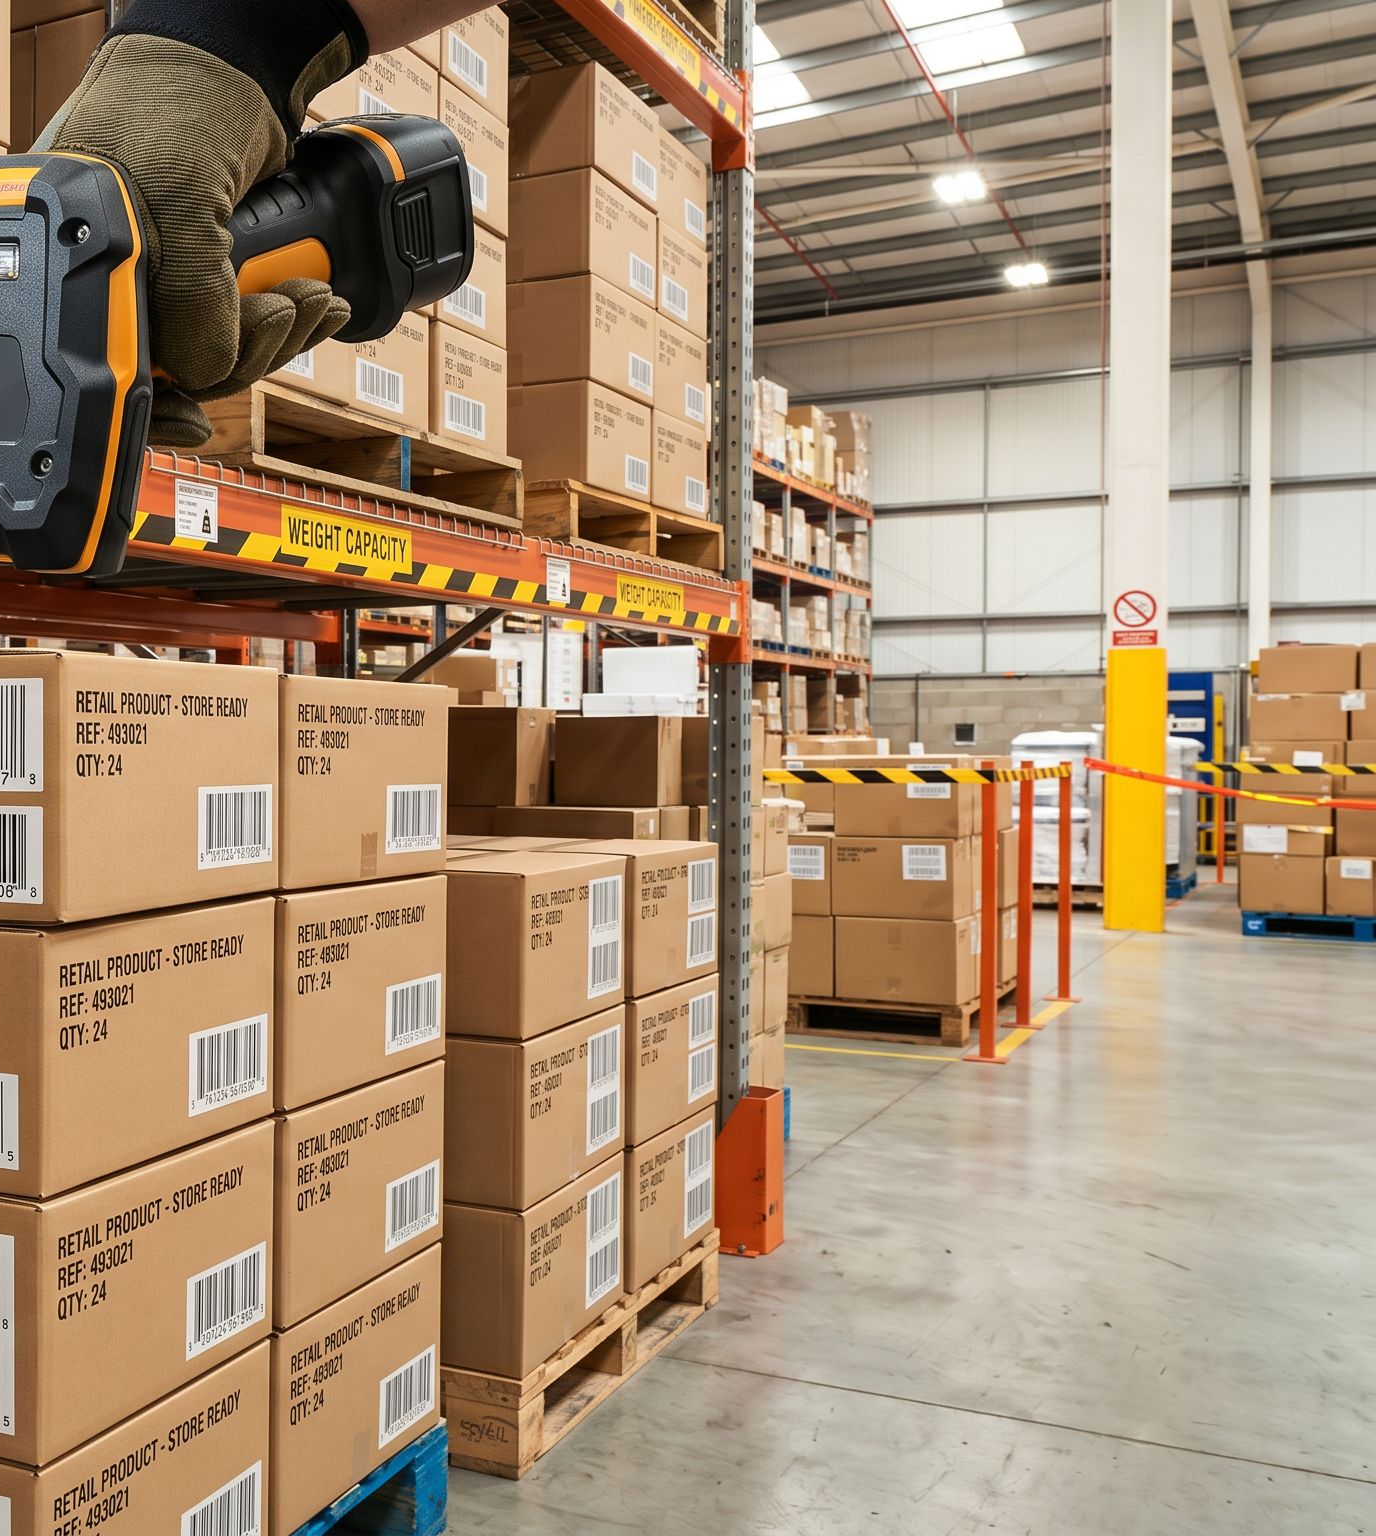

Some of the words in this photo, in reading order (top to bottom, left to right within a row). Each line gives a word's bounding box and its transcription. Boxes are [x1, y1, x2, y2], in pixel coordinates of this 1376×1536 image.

[288, 516, 341, 552] WEIGHT
[345, 527, 406, 564] CAPACITY
[76, 691, 117, 713] RETAIL
[121, 692, 171, 715] PRODUCT
[182, 695, 213, 716] STORE
[217, 697, 247, 717] READY
[298, 704, 327, 723] RETAIL
[330, 706, 367, 724] PRODUCT
[375, 708, 399, 725] STORE
[401, 709, 425, 726] READY
[77, 722, 104, 744] REF:
[108, 723, 146, 744] 493021
[298, 730, 317, 748] REF:
[29, 773, 36, 785] 3
[77, 754, 104, 777] QTY:
[108, 754, 122, 775] 24
[298, 756, 318, 775] QTY:
[321, 757, 331, 774] 24
[30, 887, 37, 898] 8
[298, 922, 328, 944] RETAIL
[330, 915, 368, 938] PRODUCT
[376, 909, 399, 930] STORE
[402, 905, 425, 925] READY
[60, 960, 103, 988] RETAIL
[108, 949, 162, 979] PRODUCT
[173, 941, 207, 966] STORE
[211, 935, 244, 959] READY
[298, 948, 318, 968] REF:
[298, 973, 318, 995] QTY:
[321, 971, 331, 989] 24
[60, 992, 88, 1019] REF:
[92, 985, 133, 1011] 493021
[60, 1023, 88, 1050] QTY:
[93, 1020, 107, 1042] 24
[58, 1224, 102, 1260] RETAIL
[107, 1198, 162, 1241] PRODUCT
[173, 1180, 207, 1213] STORE
[210, 1167, 243, 1198] READY
[58, 1260, 86, 1290] REF:
[90, 1242, 132, 1275] 493021
[58, 1291, 87, 1320] QTY:
[91, 1285, 106, 1306] 24
[54, 1477, 97, 1521] RETAIL
[102, 1439, 158, 1492] PRODUCT
[168, 1412, 204, 1451] STORE
[208, 1392, 240, 1428] READY
[85, 1489, 128, 1529] 493021
